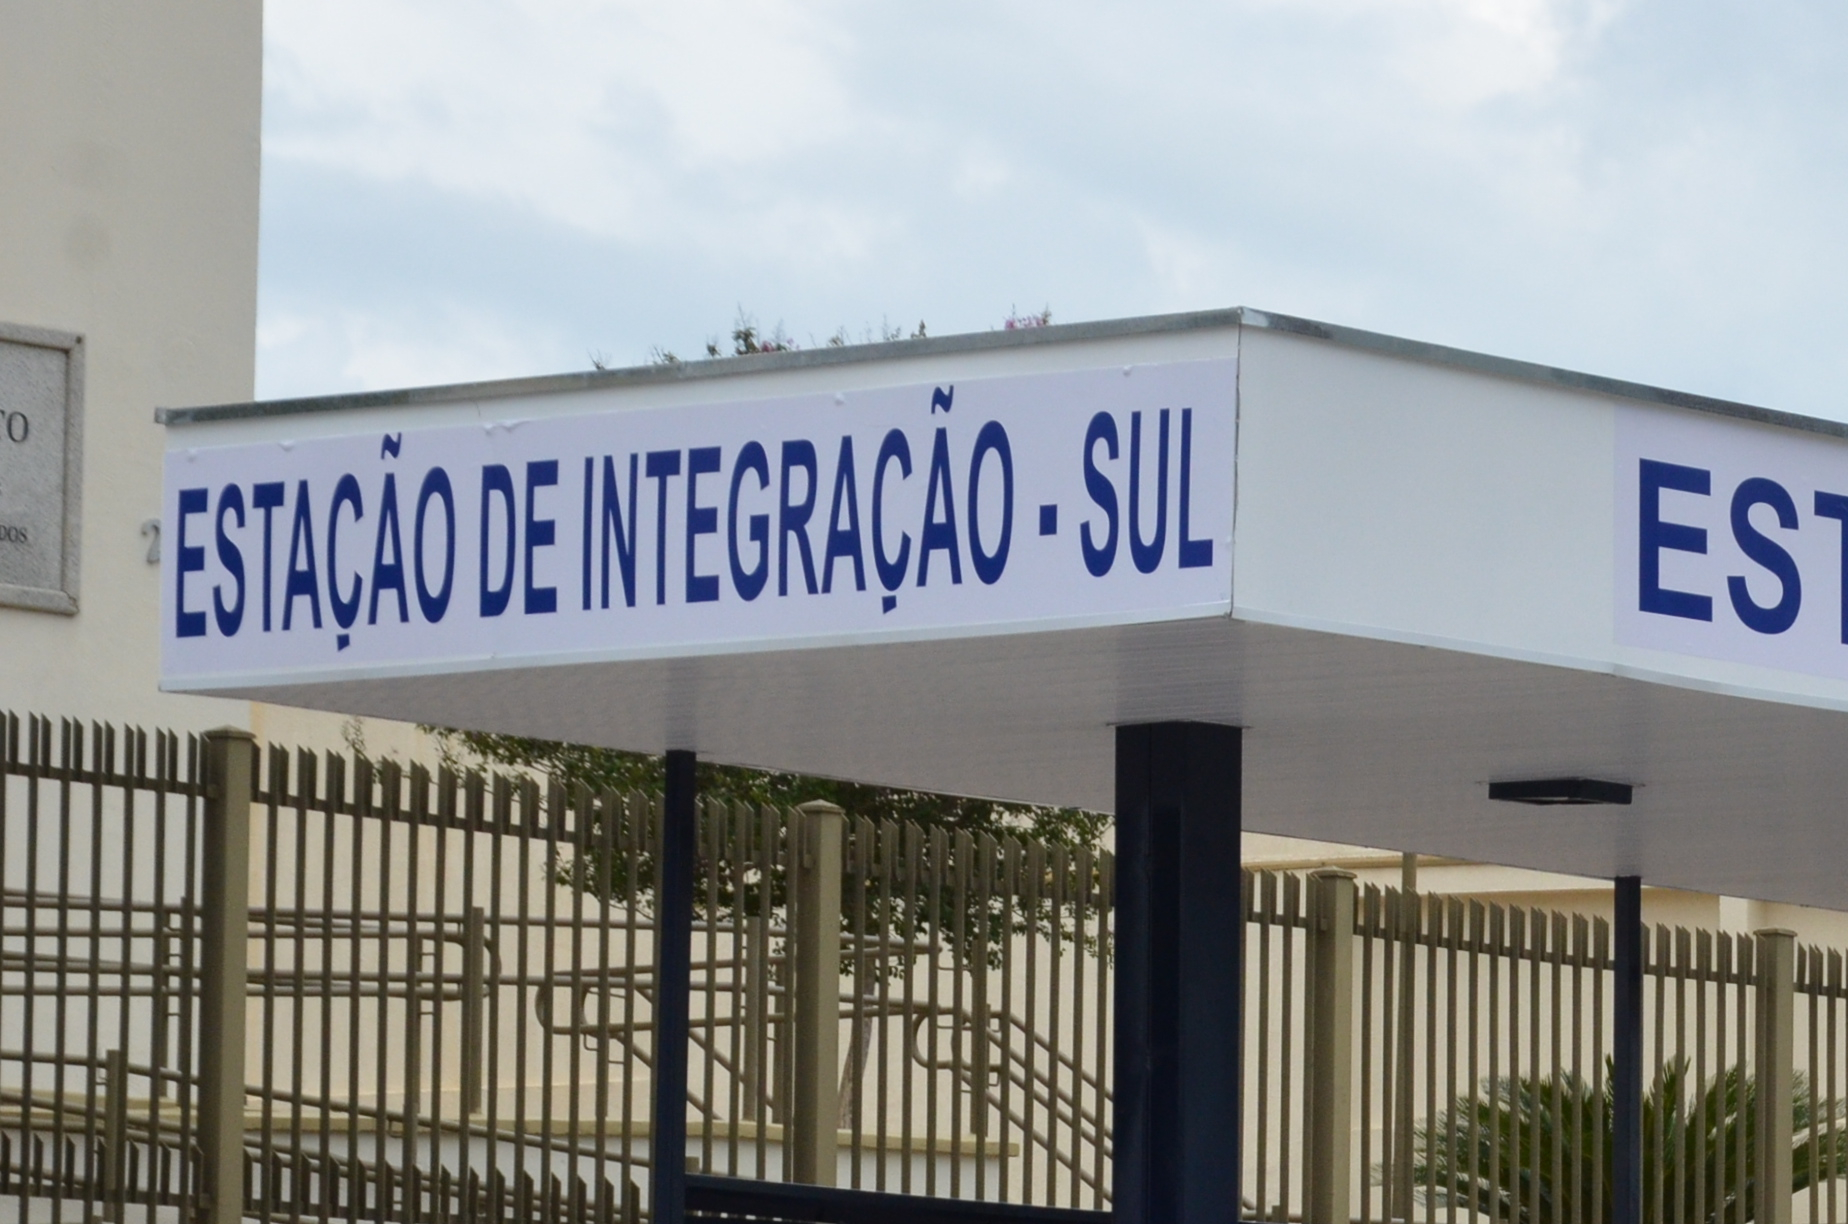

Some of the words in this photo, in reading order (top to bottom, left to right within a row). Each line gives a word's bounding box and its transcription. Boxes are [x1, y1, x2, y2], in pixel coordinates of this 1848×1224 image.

[175, 434, 456, 652] ESTAÇÃO
[479, 456, 559, 618] DE
[582, 386, 1014, 614] INTEGRAÇÃO
[1039, 504, 1058, 536] -
[1080, 407, 1214, 578] SUL
